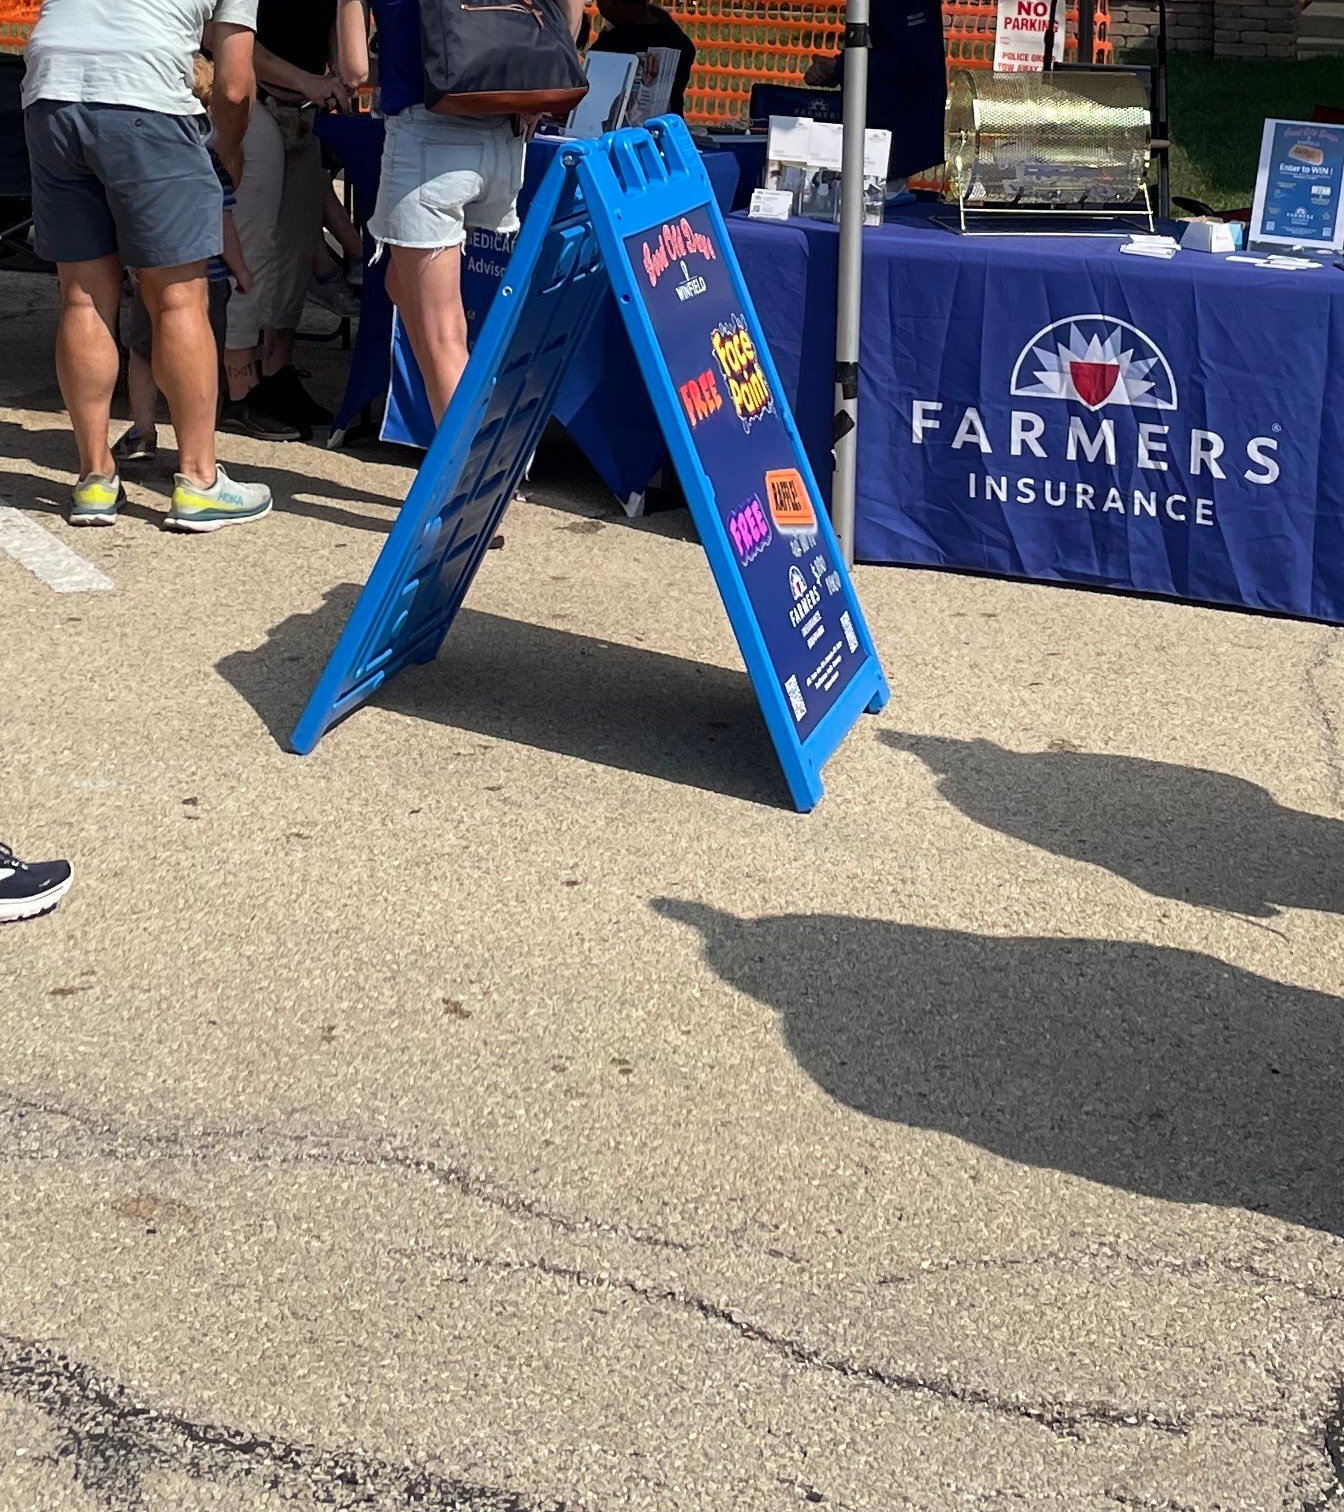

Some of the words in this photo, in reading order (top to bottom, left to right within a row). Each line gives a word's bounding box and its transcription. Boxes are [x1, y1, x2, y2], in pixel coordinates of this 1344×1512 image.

[1017, 0, 1048, 17] NO
[1002, 52, 1029, 62] POLICE
[1279, 163, 1301, 172] Enter
[1302, 165, 1310, 173] to
[1311, 166, 1329, 175] WIN
[642, 234, 669, 288] Good
[662, 224, 687, 260] Old
[680, 217, 717, 260] Days
[675, 276, 707, 302] WINFIELD
[711, 328, 756, 378] Face
[679, 368, 723, 430] FREE
[911, 399, 1281, 485] FARMERS
[218, 490, 244, 507] HOKA
[968, 472, 1215, 526] INSURANCE
[728, 498, 768, 557] FREE
[789, 585, 821, 628] FARMERS
